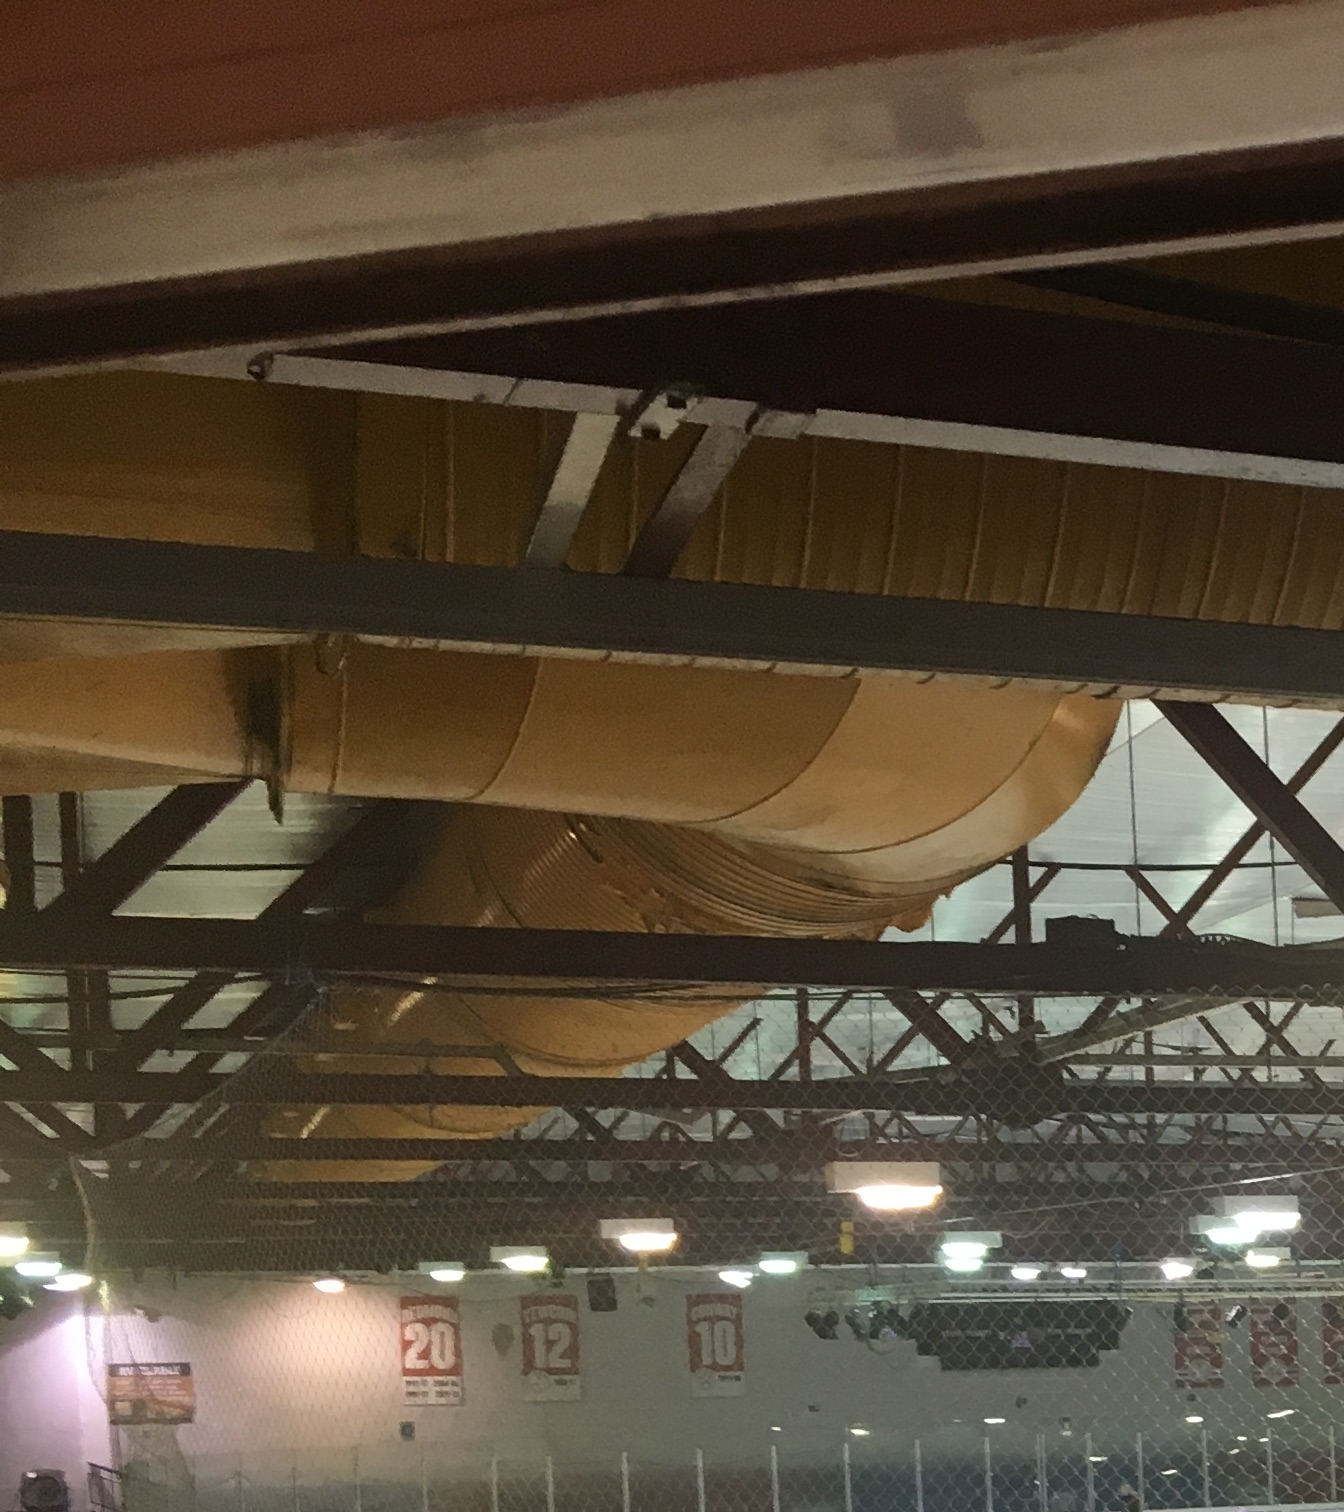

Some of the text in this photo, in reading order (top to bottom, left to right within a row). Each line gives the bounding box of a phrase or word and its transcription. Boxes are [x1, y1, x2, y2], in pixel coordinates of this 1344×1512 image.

[404, 1321, 456, 1370] 20
[527, 1322, 573, 1369] 12
[694, 1319, 737, 1366] 10
